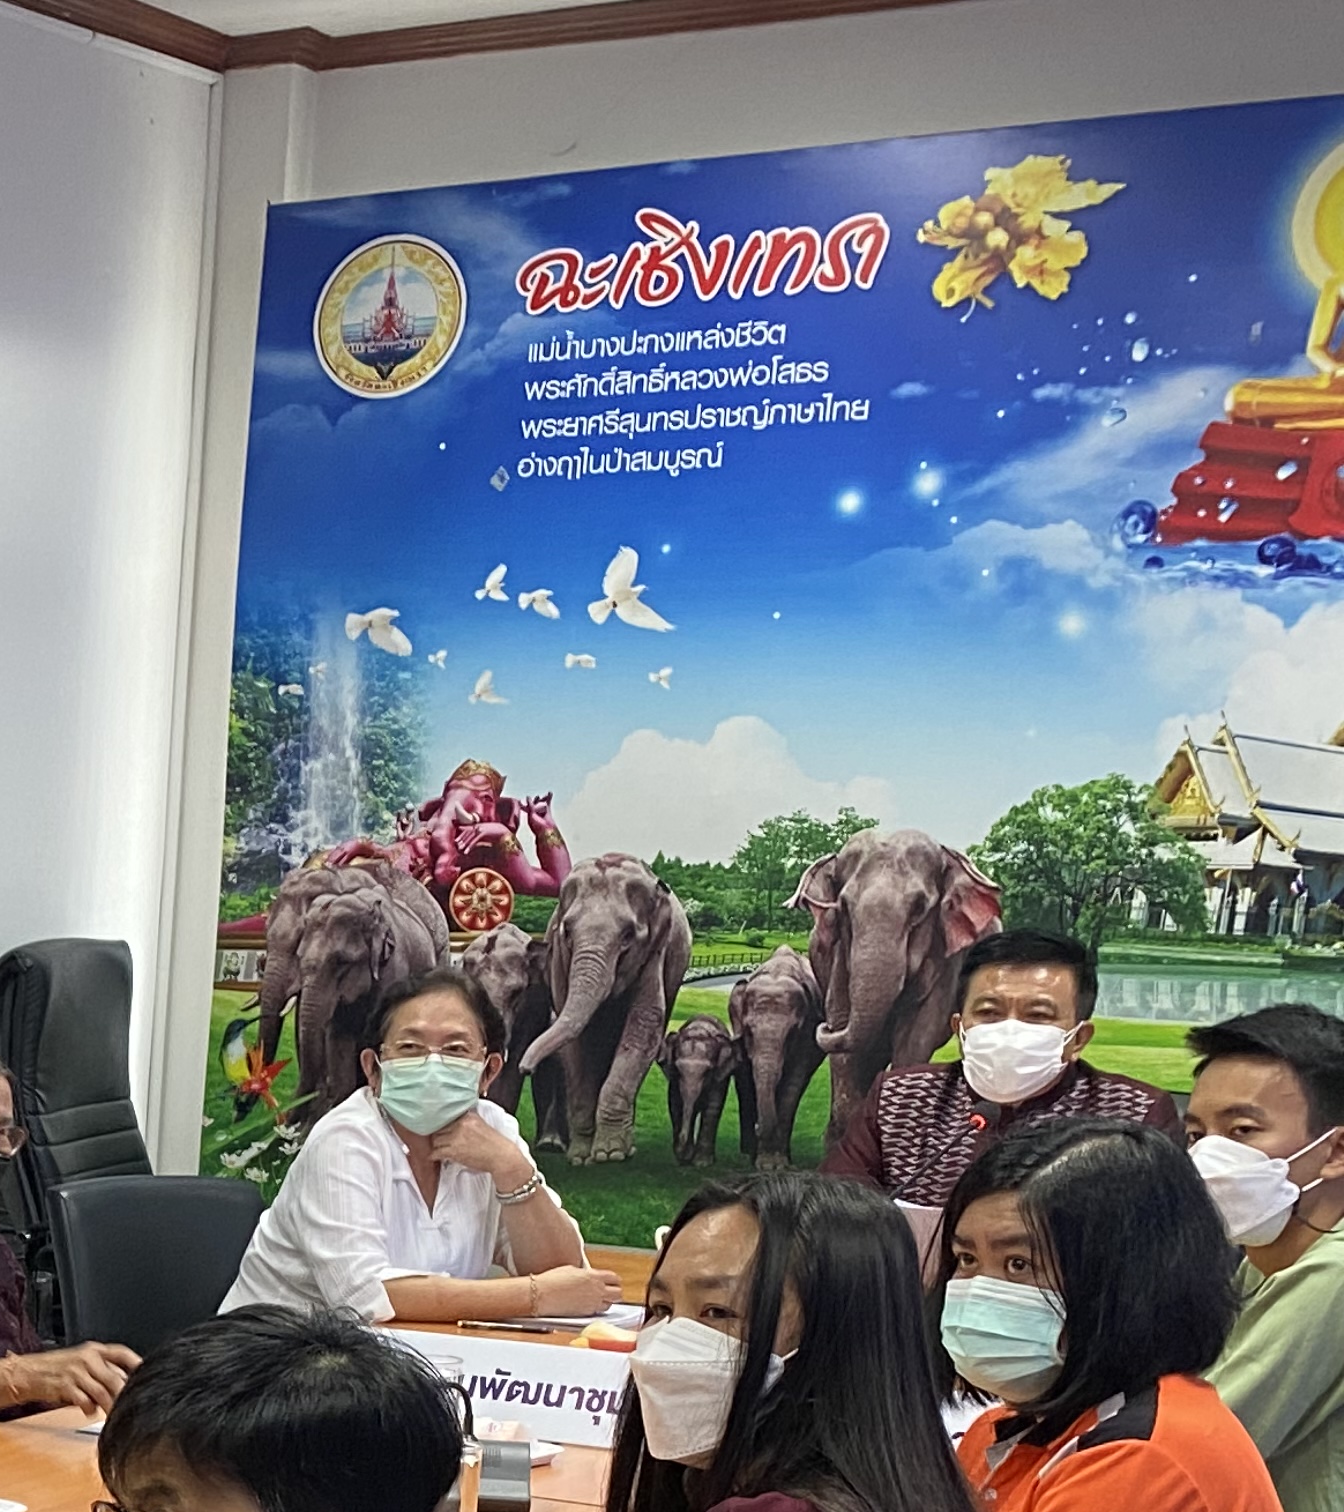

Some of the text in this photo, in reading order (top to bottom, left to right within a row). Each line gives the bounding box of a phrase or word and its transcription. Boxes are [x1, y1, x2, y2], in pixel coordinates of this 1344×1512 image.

[517, 208, 889, 314] ฉะเชิงเทรา
[527, 321, 786, 364] แม่น้ำบางปะกงแหล่งชีวิต
[524, 357, 829, 401] พระศักดิ์สิทธิ์หลวงพ่อโสธร
[521, 393, 870, 440] พระยาศรีสุนทรปราชญ์ภาษาไทย
